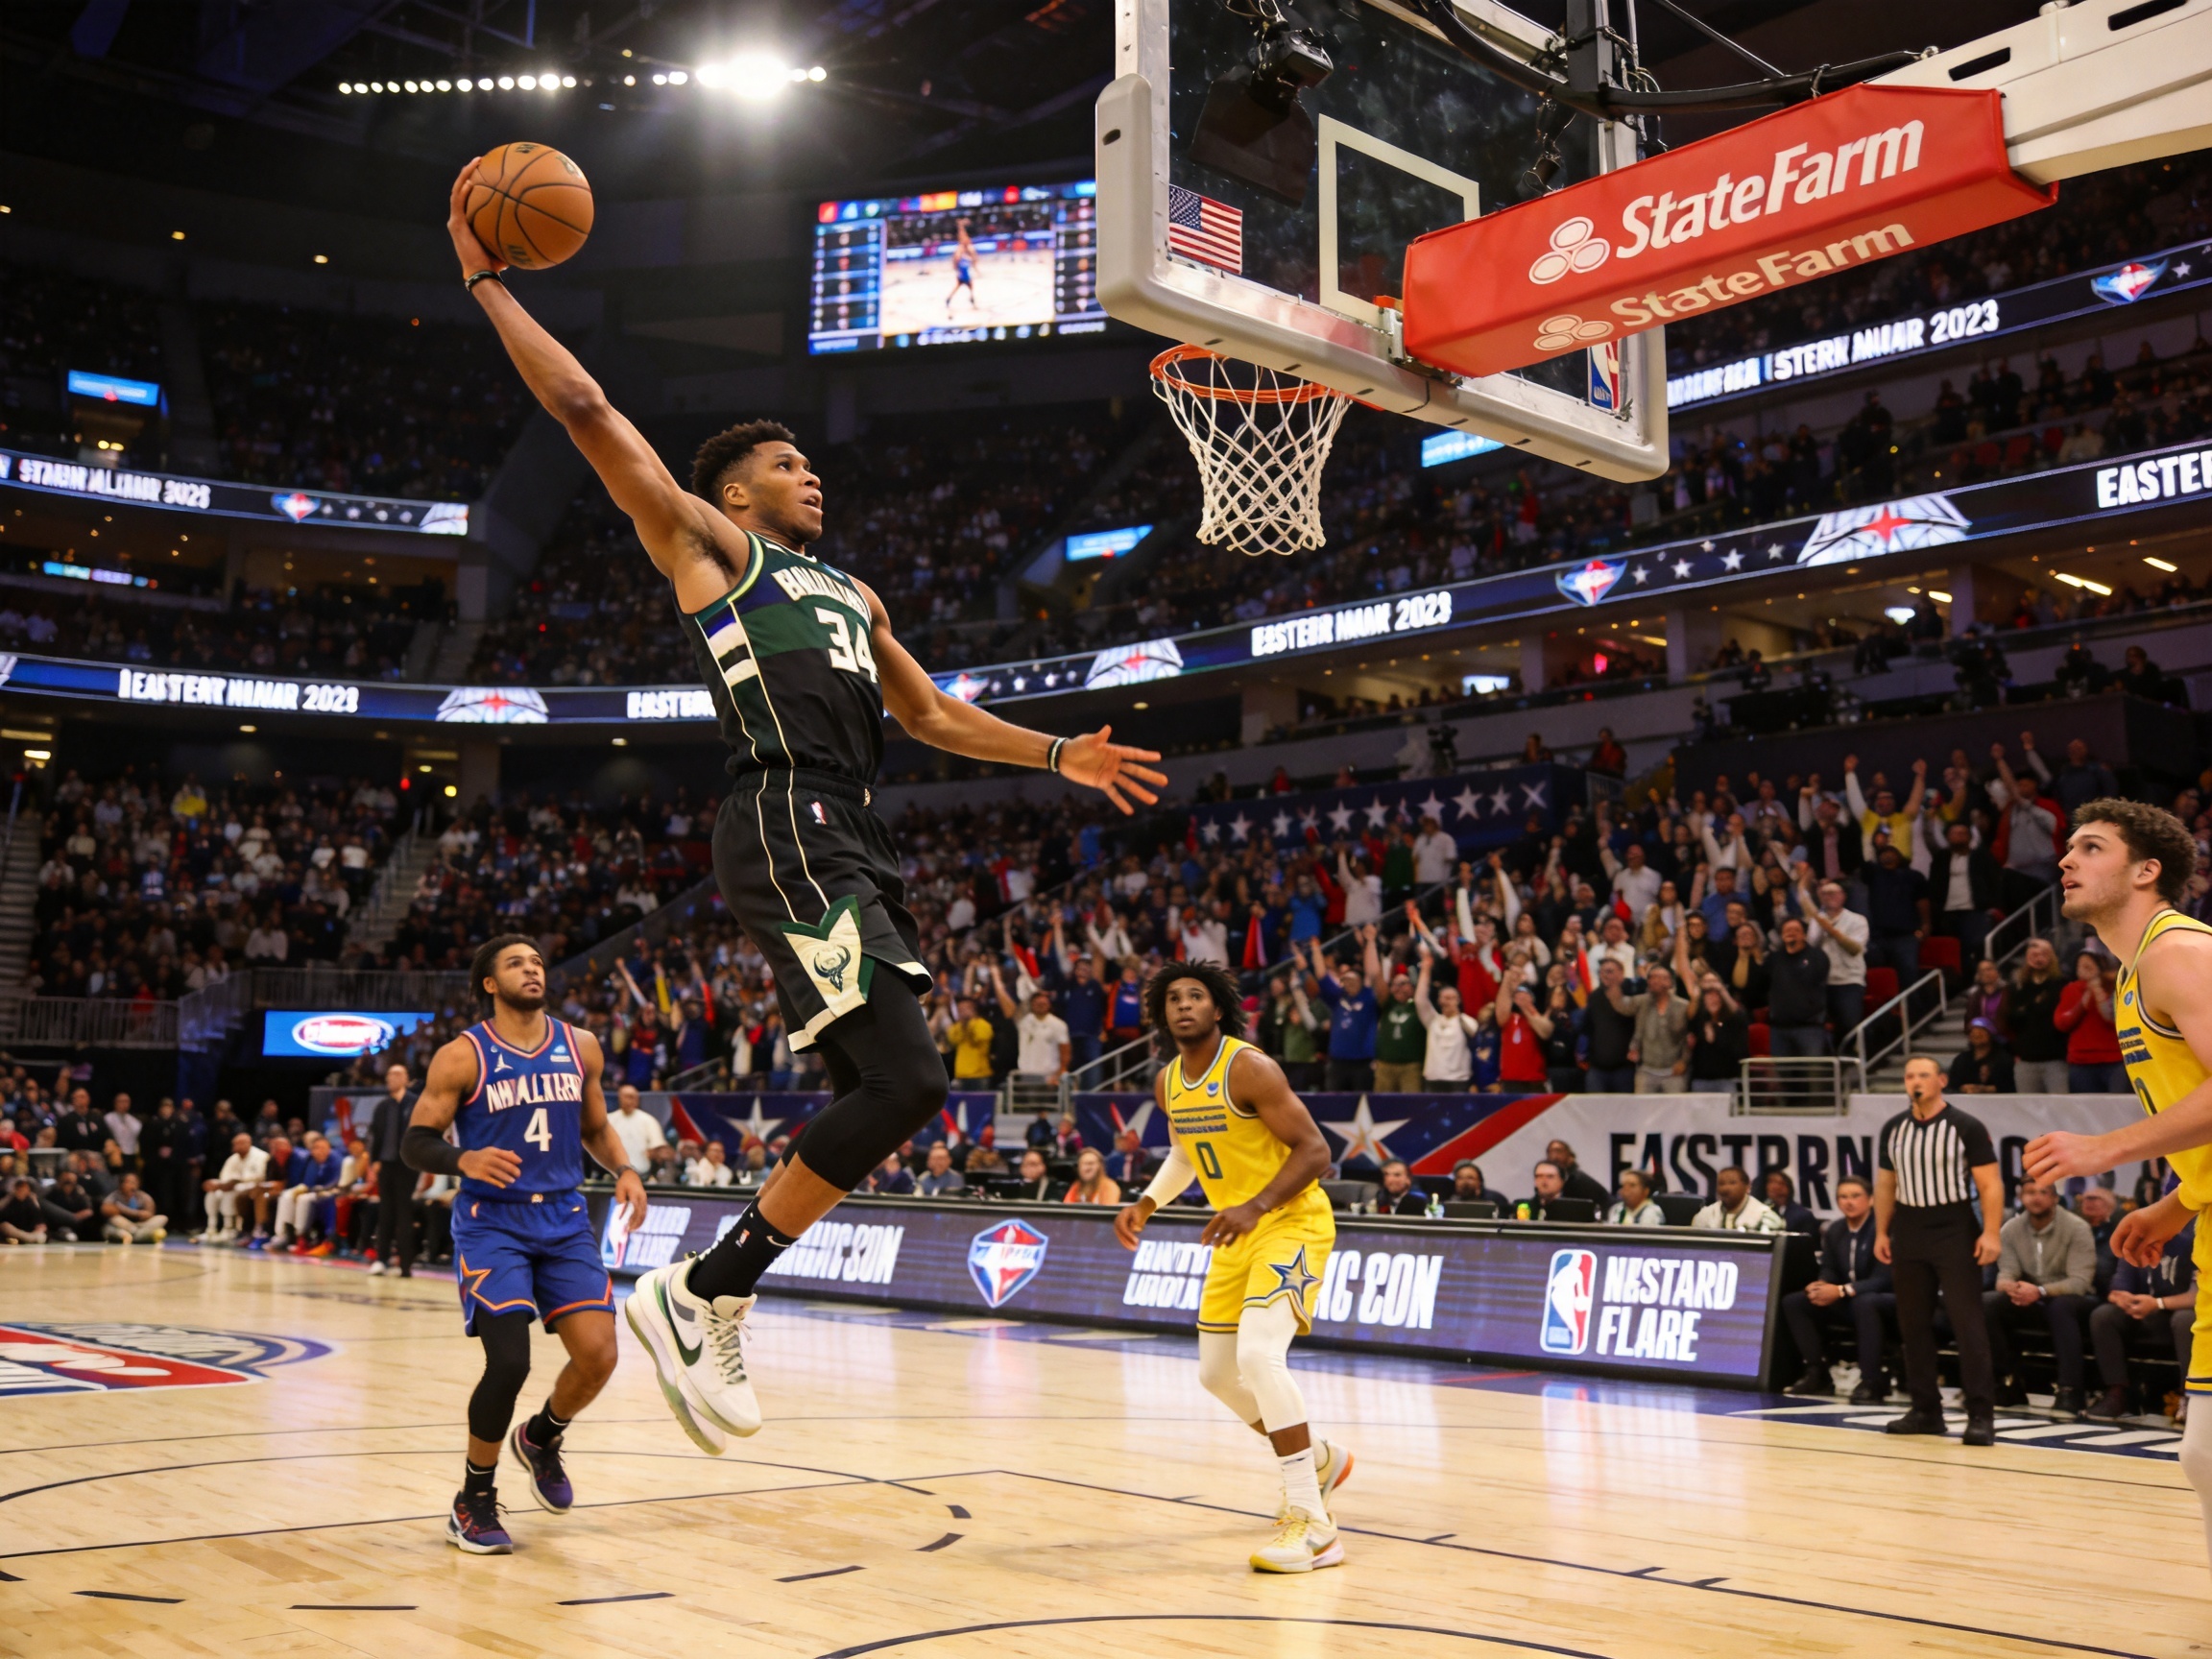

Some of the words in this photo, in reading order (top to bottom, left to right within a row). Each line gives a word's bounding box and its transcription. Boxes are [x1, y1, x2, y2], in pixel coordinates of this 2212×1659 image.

[1616, 119, 1925, 259] StateFarm
[1610, 223, 1915, 327] StateFarm
[1930, 300, 2000, 344] 2023
[1394, 591, 1452, 631] 2023
[814, 607, 878, 684] 34
[524, 1108, 553, 1152] 4
[1195, 1142, 1224, 1179] 0
[1596, 1306, 1701, 1361] FLARE
